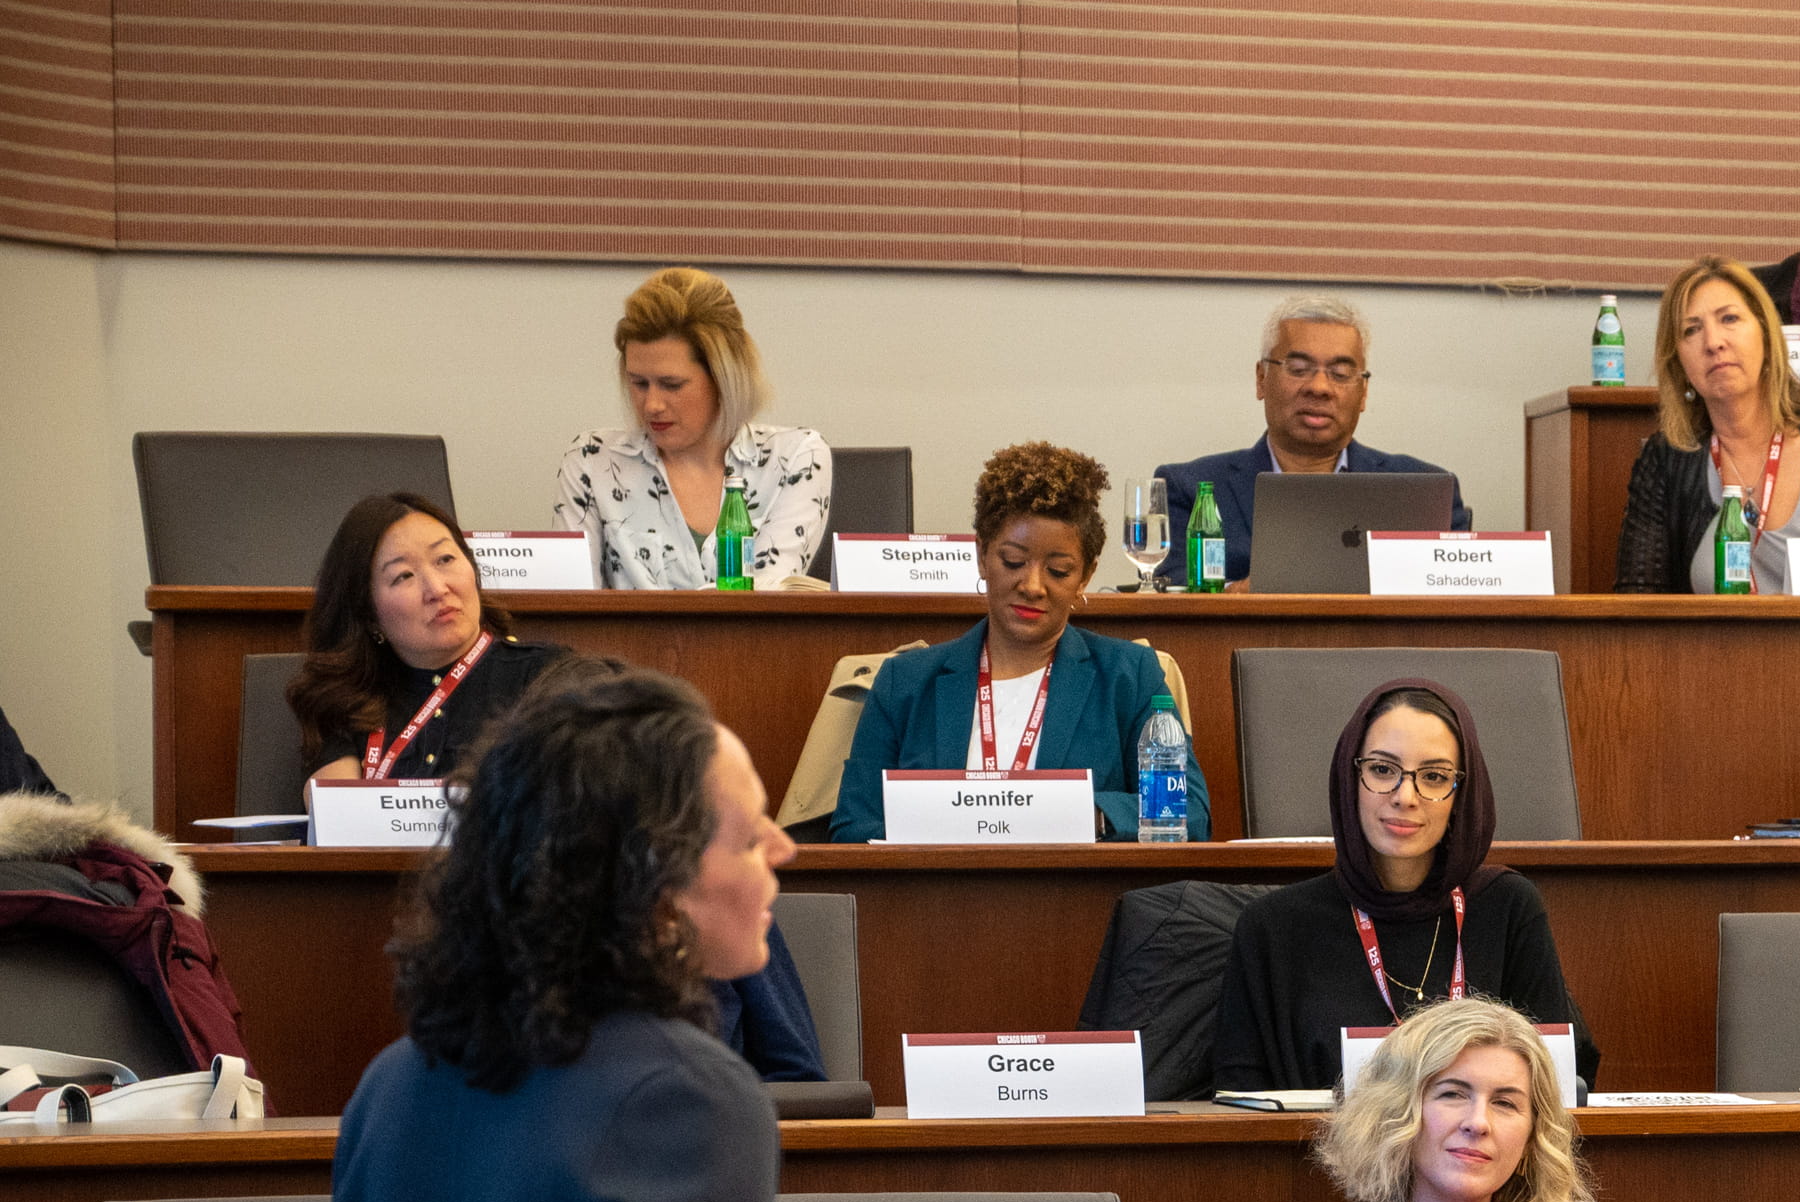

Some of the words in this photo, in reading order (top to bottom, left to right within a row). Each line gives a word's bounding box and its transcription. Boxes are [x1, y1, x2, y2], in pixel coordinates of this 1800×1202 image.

[475, 547, 533, 558] annon
[882, 548, 972, 563] Stephanie
[1433, 549, 1493, 562] Robert
[909, 569, 949, 580] Smith
[1426, 574, 1502, 586] Sahadevan
[450, 663, 467, 680] 125
[980, 685, 991, 701] 125
[400, 725, 417, 740] 125
[1022, 730, 1036, 747] 125
[367, 747, 379, 764] 125
[985, 757, 995, 770] 12
[380, 795, 447, 810] Eunhe
[951, 790, 1034, 807] Jennifer
[977, 820, 1011, 834] Polk
[1367, 945, 1380, 967] 125
[1452, 986, 1462, 1001] 25
[988, 1055, 1055, 1072] Grace
[998, 1086, 1049, 1100] Burns
